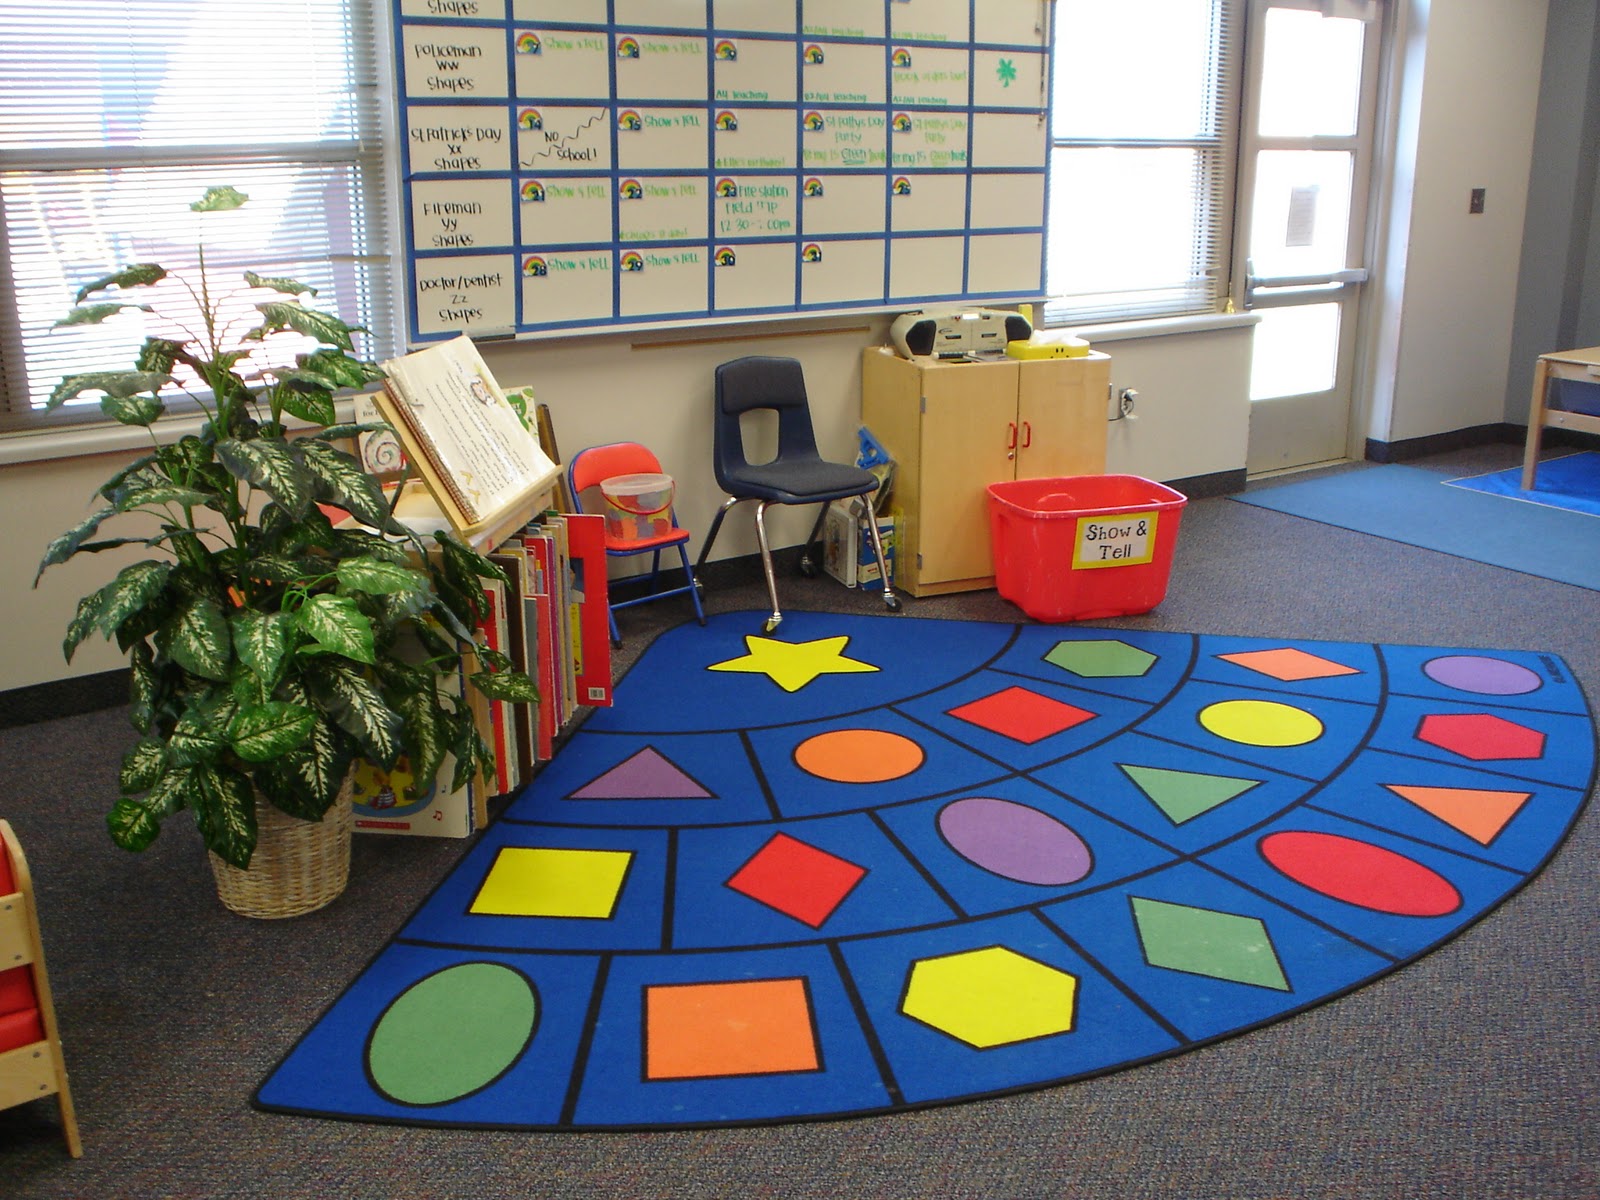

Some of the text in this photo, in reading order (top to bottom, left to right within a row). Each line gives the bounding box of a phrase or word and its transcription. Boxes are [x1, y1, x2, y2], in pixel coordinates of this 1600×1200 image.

[415, 44, 482, 58] Policeman
[812, 53, 824, 64] 10
[903, 56, 911, 67] 11
[529, 118, 541, 131] 14
[629, 118, 641, 130] 15
[725, 119, 737, 131] 16
[476, 128, 501, 143] Day
[532, 189, 544, 201] 21
[628, 188, 642, 199] 22
[724, 187, 737, 197] 23
[423, 202, 482, 216] Fireman
[629, 260, 643, 271] 29
[721, 255, 735, 266] 30
[532, 265, 547, 276] 28
[1086, 520, 1147, 541] Show &
[1099, 543, 1132, 560] Tell
